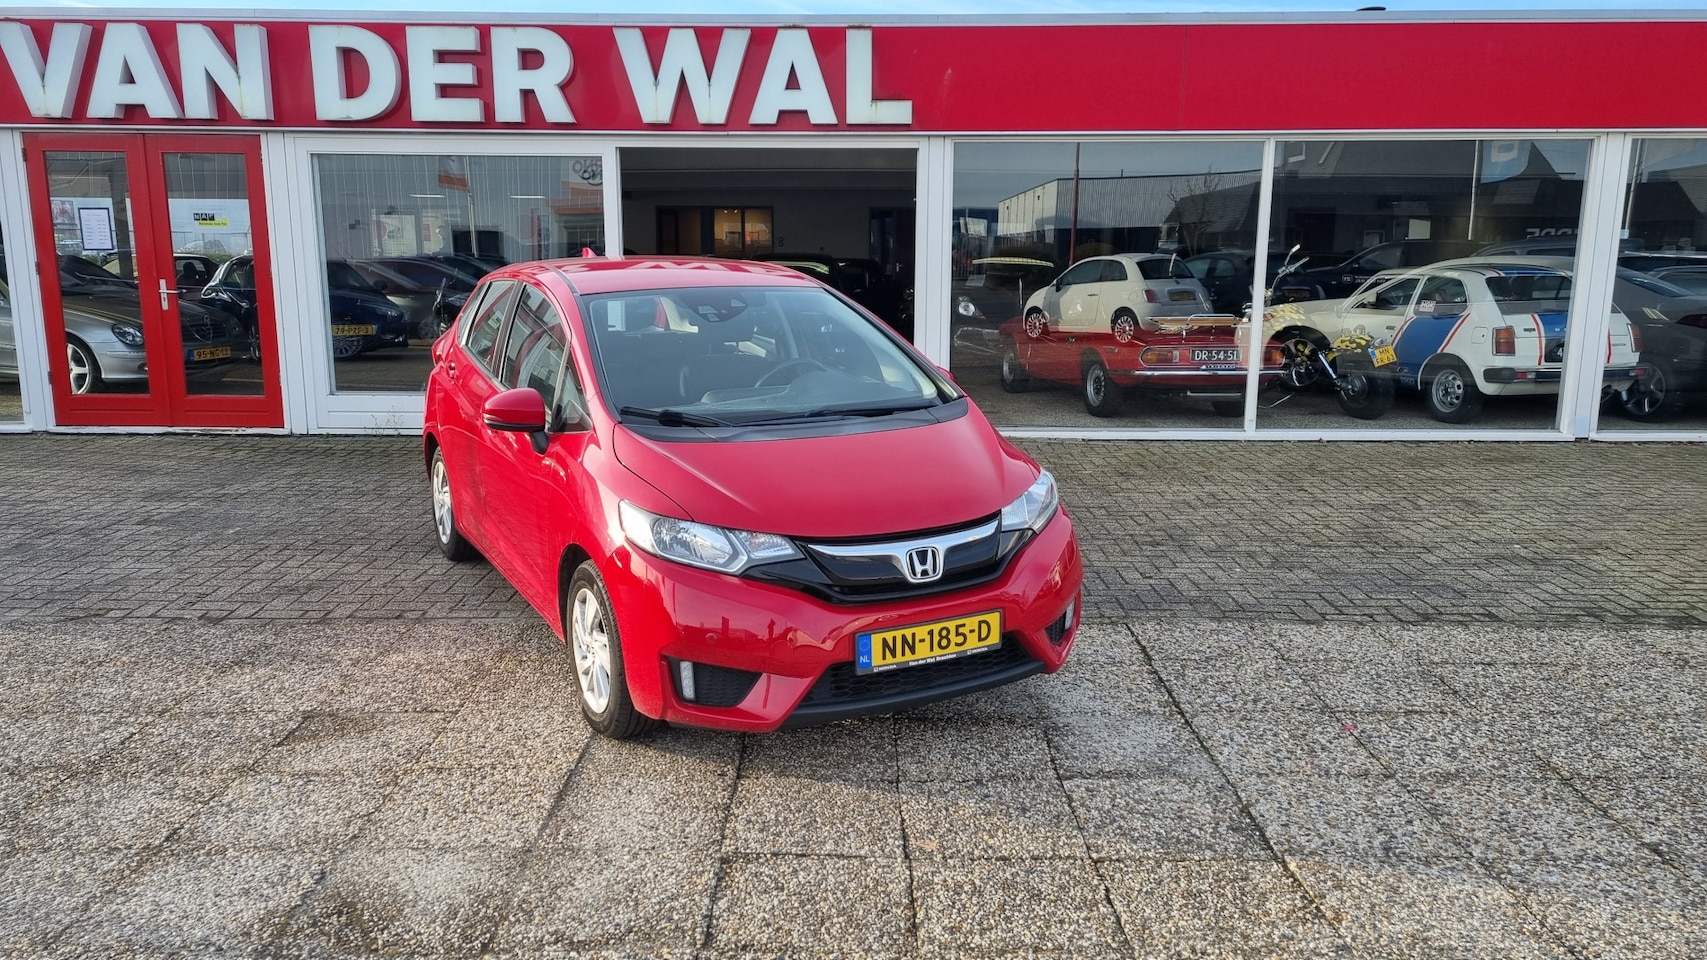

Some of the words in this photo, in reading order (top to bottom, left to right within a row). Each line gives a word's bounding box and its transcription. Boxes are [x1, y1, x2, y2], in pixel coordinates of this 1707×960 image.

[0, 21, 274, 121] VAN
[308, 24, 578, 123] DER
[612, 25, 913, 125] WAL
[1379, 347, 1390, 356] MN
[881, 619, 992, 661] NN-185-D
[859, 655, 871, 664] NL
